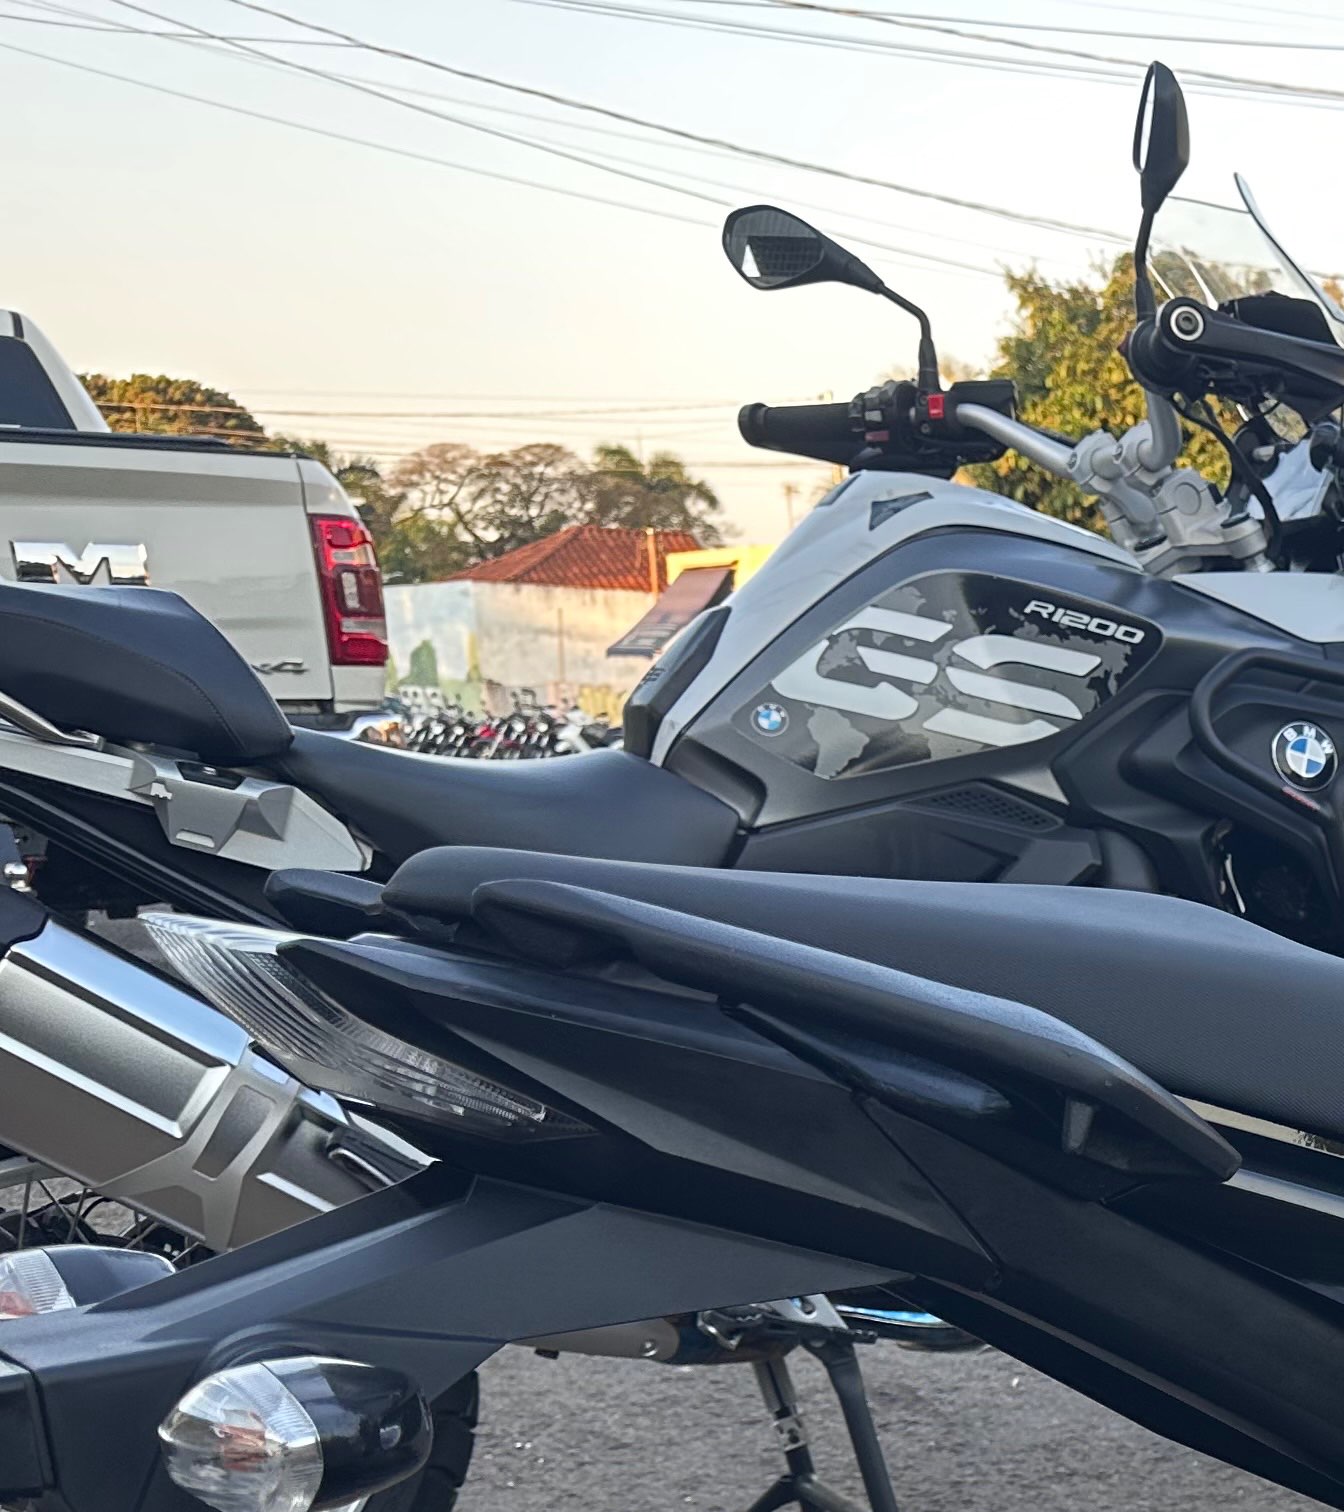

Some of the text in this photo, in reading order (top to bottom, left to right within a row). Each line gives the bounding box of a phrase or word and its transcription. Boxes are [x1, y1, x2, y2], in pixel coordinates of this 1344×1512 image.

[1024, 599, 1145, 645] R1200
[772, 605, 1101, 747] GS
[1282, 725, 1335, 755] BMW
